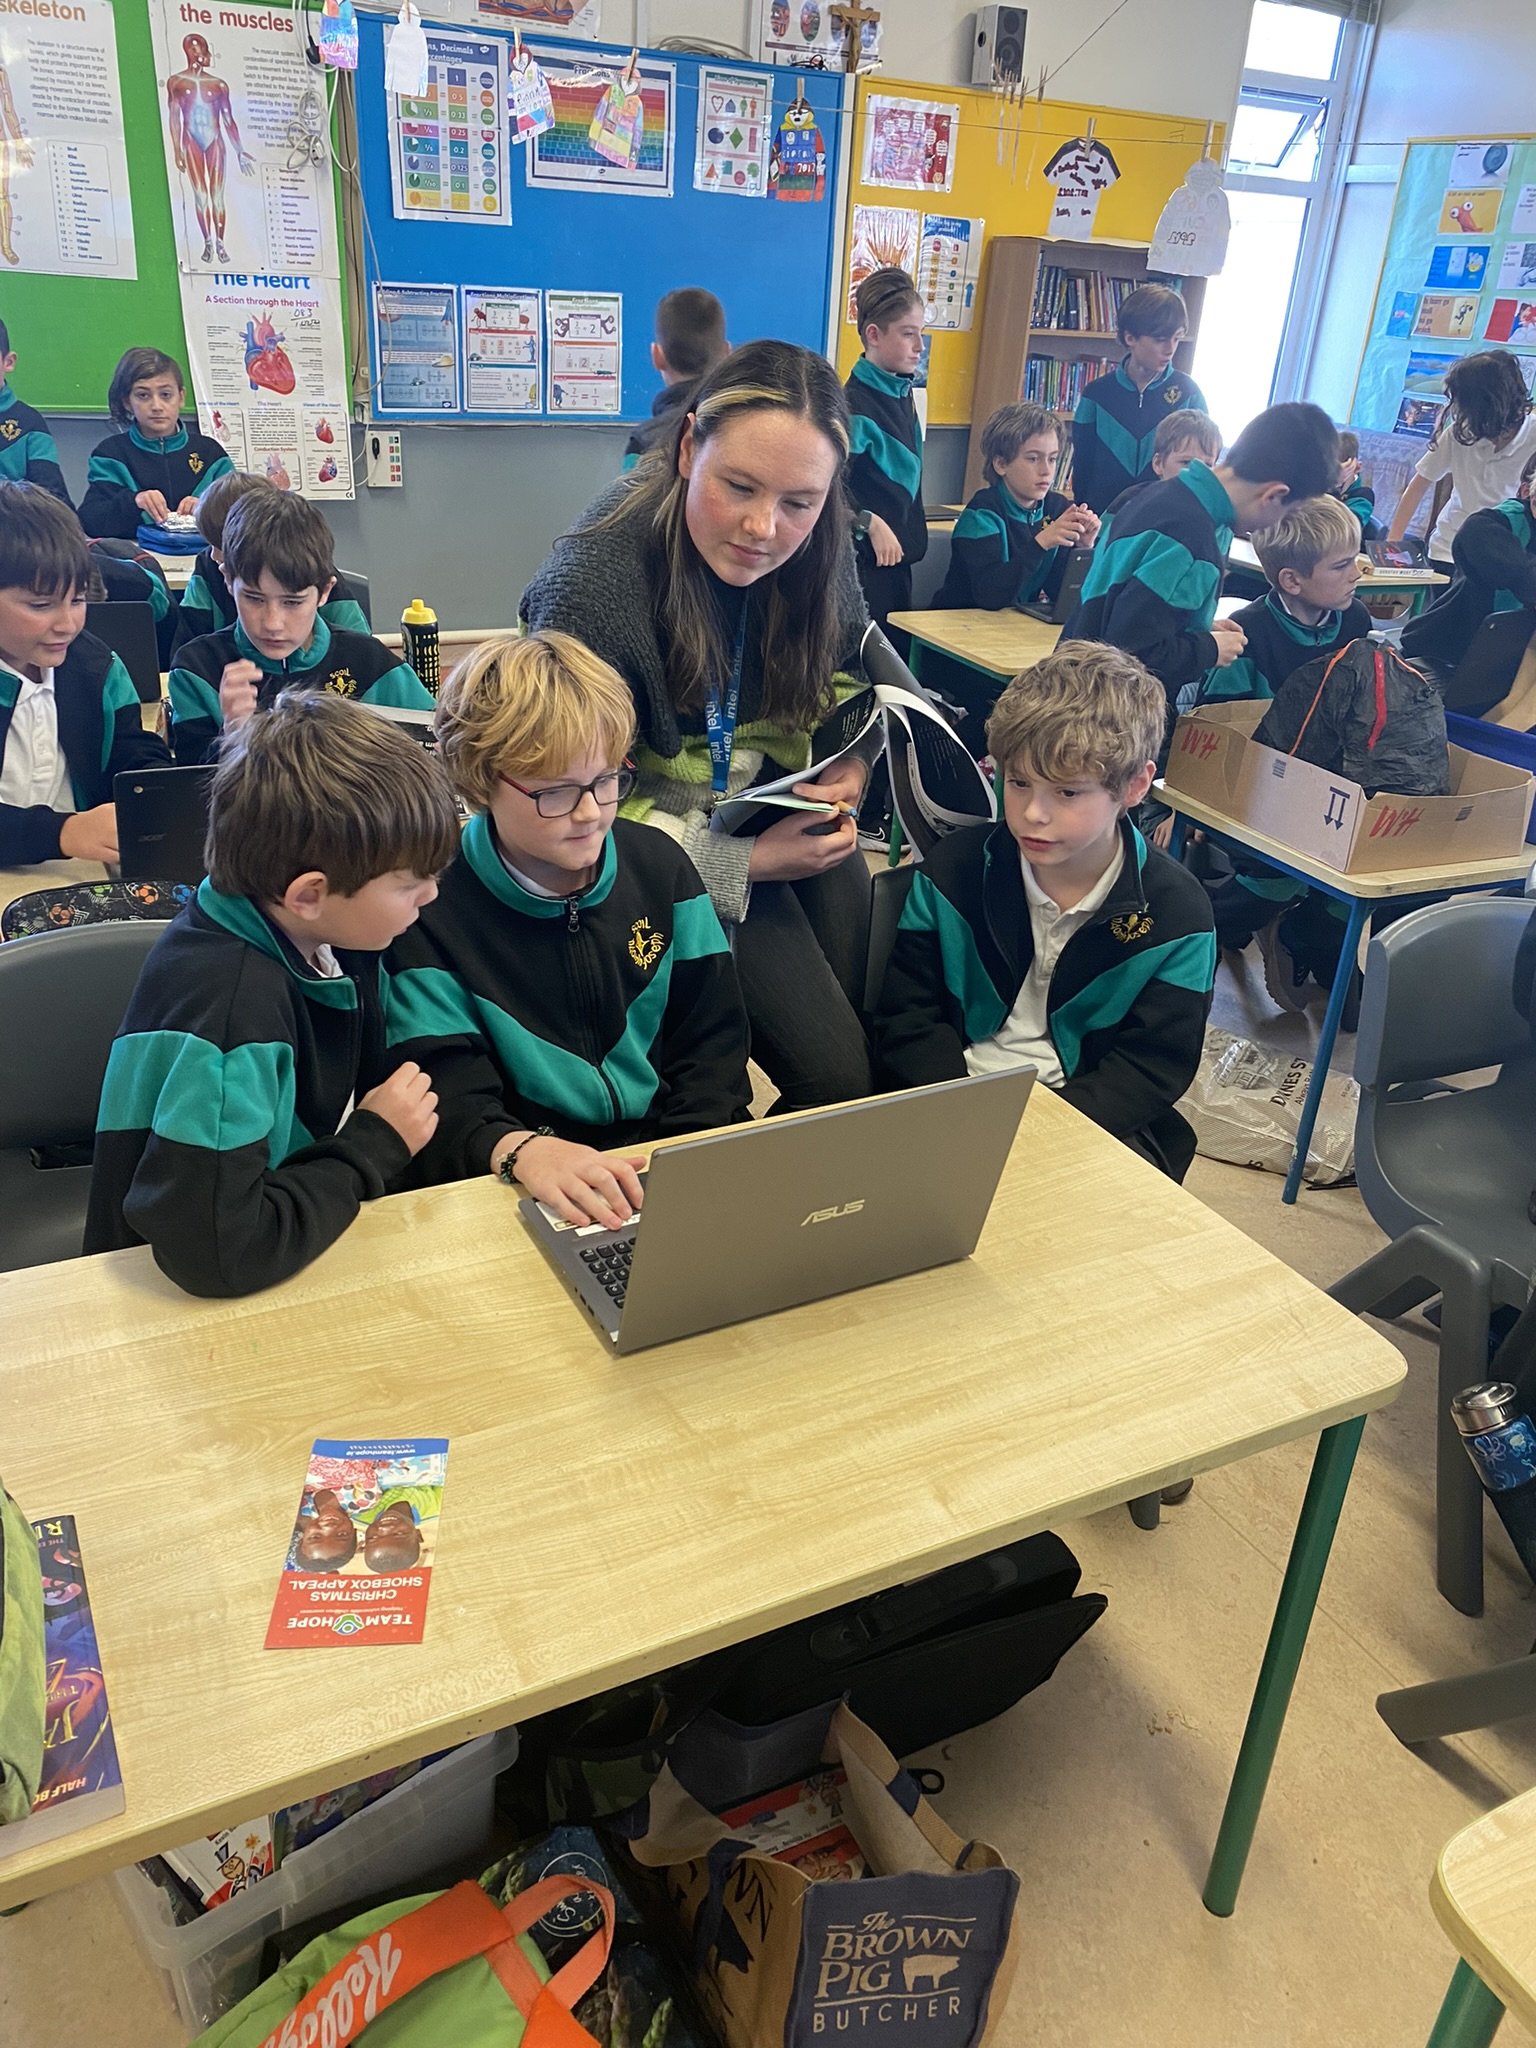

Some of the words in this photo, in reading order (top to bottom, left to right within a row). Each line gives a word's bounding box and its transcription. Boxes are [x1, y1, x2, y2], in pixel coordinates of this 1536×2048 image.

[180, 4, 212, 25] the
[219, 10, 294, 33] muscles
[440, 43, 474, 55] Decimals
[428, 54, 462, 64] rcentages
[253, 275, 310, 289] Heart
[214, 296, 245, 305] Section
[246, 297, 279, 307] through
[727, 688, 737, 719] intel
[711, 741, 725, 763] intel
[800, 1199, 865, 1228] ASUS
[289, 1579, 348, 1590] APPEAL
[350, 1577, 423, 1589] SHOEBOX
[310, 1589, 397, 1601] CHRISTMAS
[287, 1616, 333, 1628] HOPE
[365, 1614, 413, 1626] TEAM
[51, 1777, 86, 1797] HALF
[858, 1910, 896, 1933] The
[821, 1925, 974, 1962] BROWN
[814, 1958, 892, 1998] PIG
[813, 1996, 961, 2033] BUTCHER
